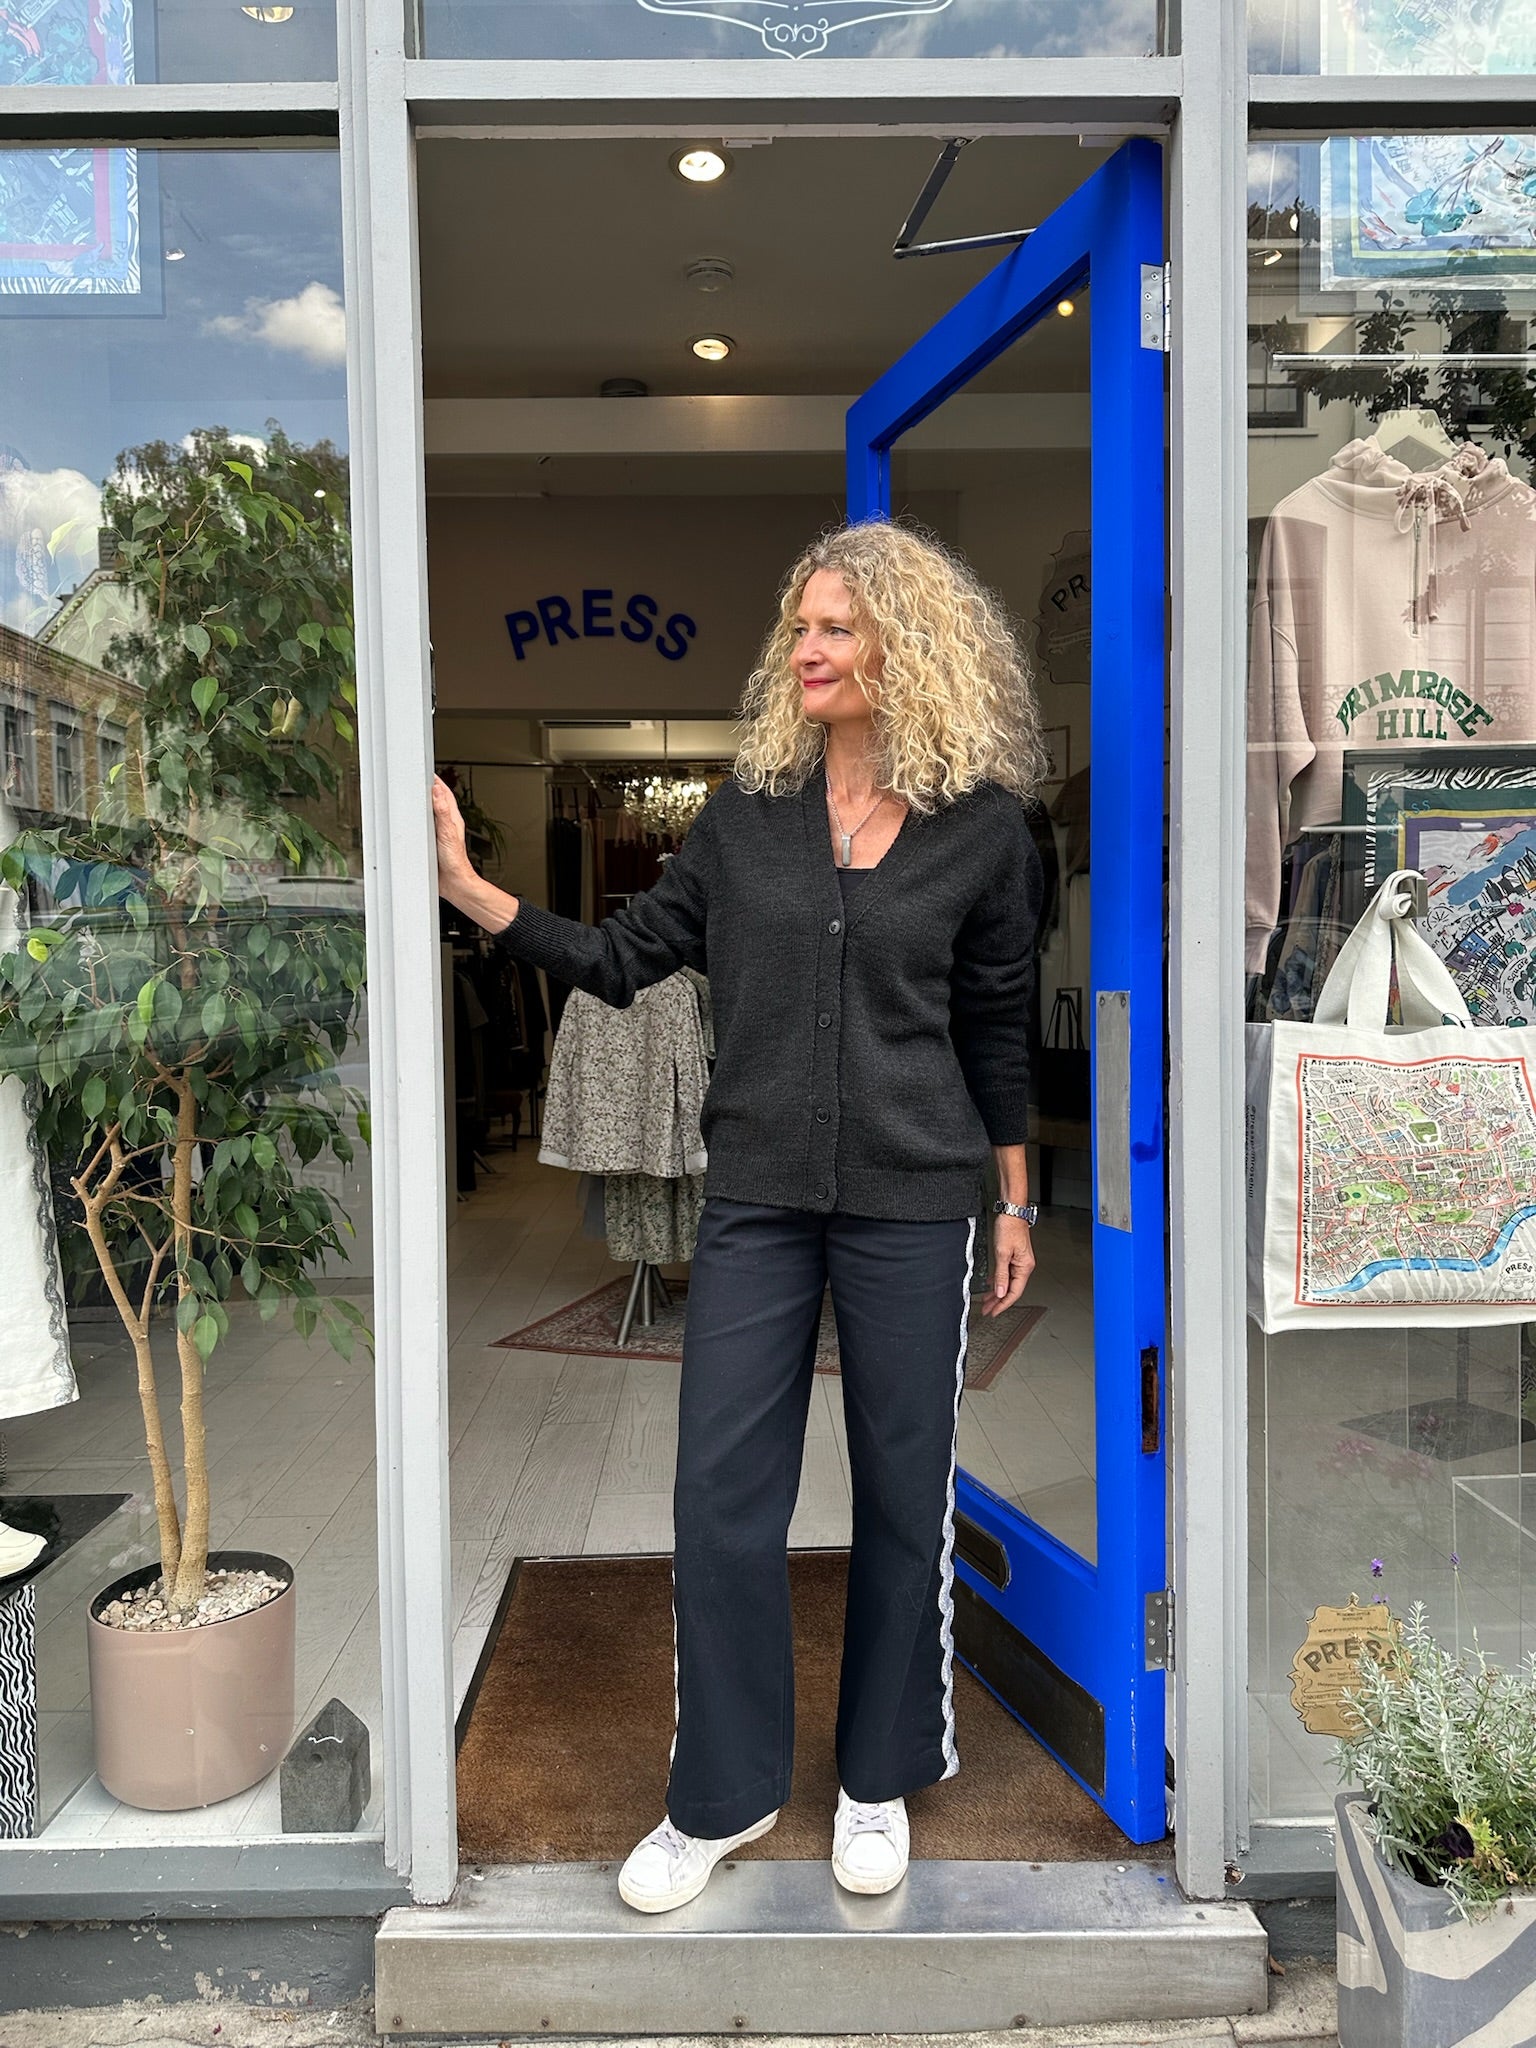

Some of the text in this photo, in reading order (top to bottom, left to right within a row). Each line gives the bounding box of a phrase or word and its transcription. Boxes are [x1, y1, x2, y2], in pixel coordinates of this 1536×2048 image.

[1051, 574, 1092, 613] PR
[504, 589, 697, 661] PRESS
[1335, 669, 1495, 738] PRIMROSE
[1376, 708, 1448, 741] HILL
[1505, 1262, 1533, 1274] PRESS
